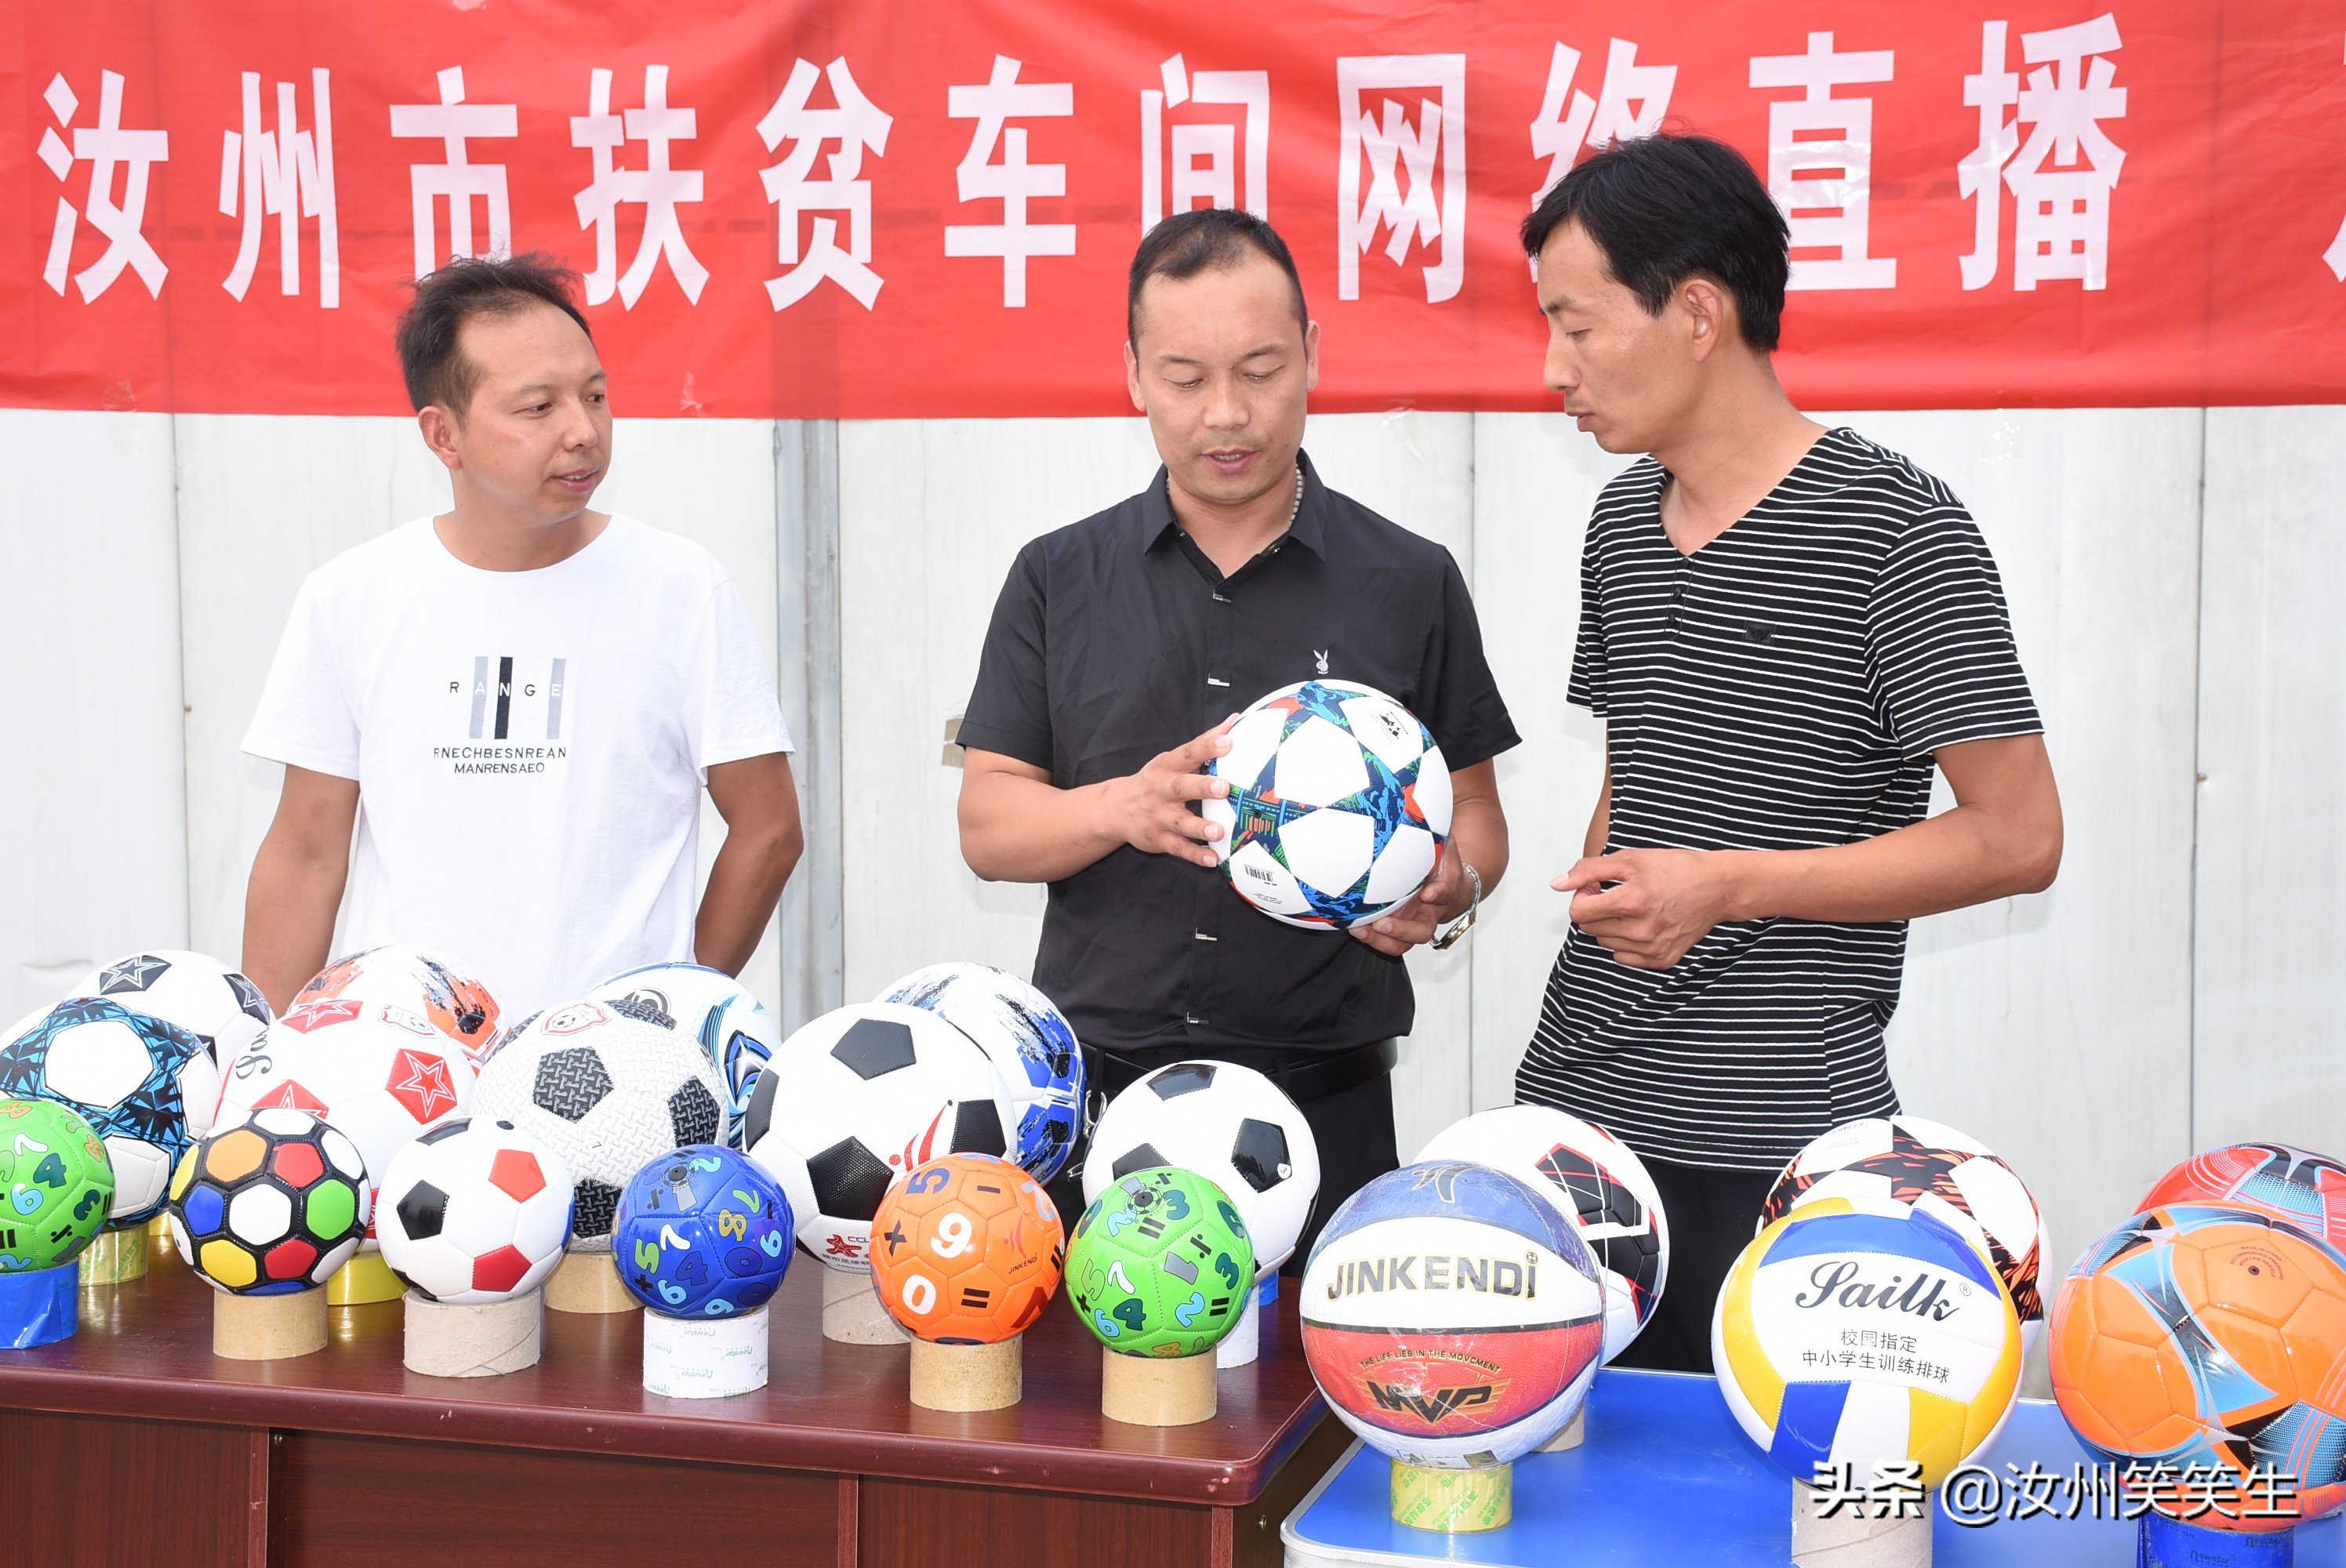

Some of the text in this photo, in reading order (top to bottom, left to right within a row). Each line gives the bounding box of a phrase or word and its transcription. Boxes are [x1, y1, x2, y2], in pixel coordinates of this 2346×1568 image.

[449, 681, 562, 698] RANGE
[454, 762, 546, 774] MANRENSAEO
[931, 1212, 972, 1258] 9
[902, 1275, 936, 1315] 0
[1795, 1261, 1960, 1322] Sailk
[1113, 1298, 1146, 1330] 4
[1840, 1328, 1917, 1354] 校园指定
[1360, 1356, 1375, 1368] THE
[1376, 1353, 1393, 1363] LIFE
[1394, 1349, 1413, 1358] LIES
[1429, 1349, 1447, 1358] THE
[1803, 1348, 1950, 1384] 中小学生训练排球
[1366, 1380, 1492, 1425] MVP
